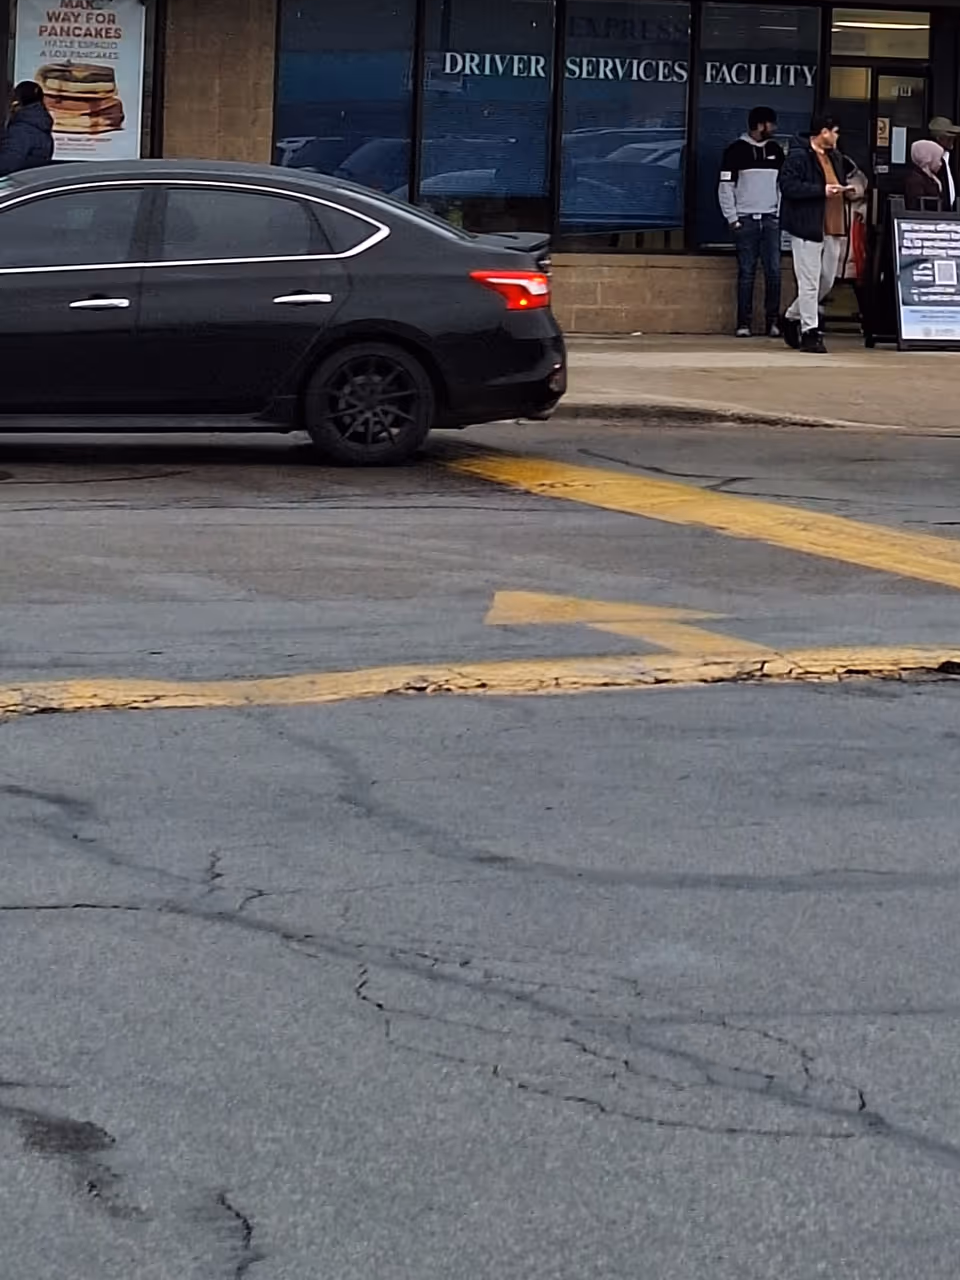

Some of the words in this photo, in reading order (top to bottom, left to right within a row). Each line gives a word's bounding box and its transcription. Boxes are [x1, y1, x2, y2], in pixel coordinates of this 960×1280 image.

[46, 11, 81, 23] WAY
[86, 13, 116, 25] FOR
[38, 25, 122, 39] PANCAKES
[443, 51, 546, 78] DRIVER
[565, 55, 689, 83] SERVICES
[704, 60, 818, 87] FACILITY
